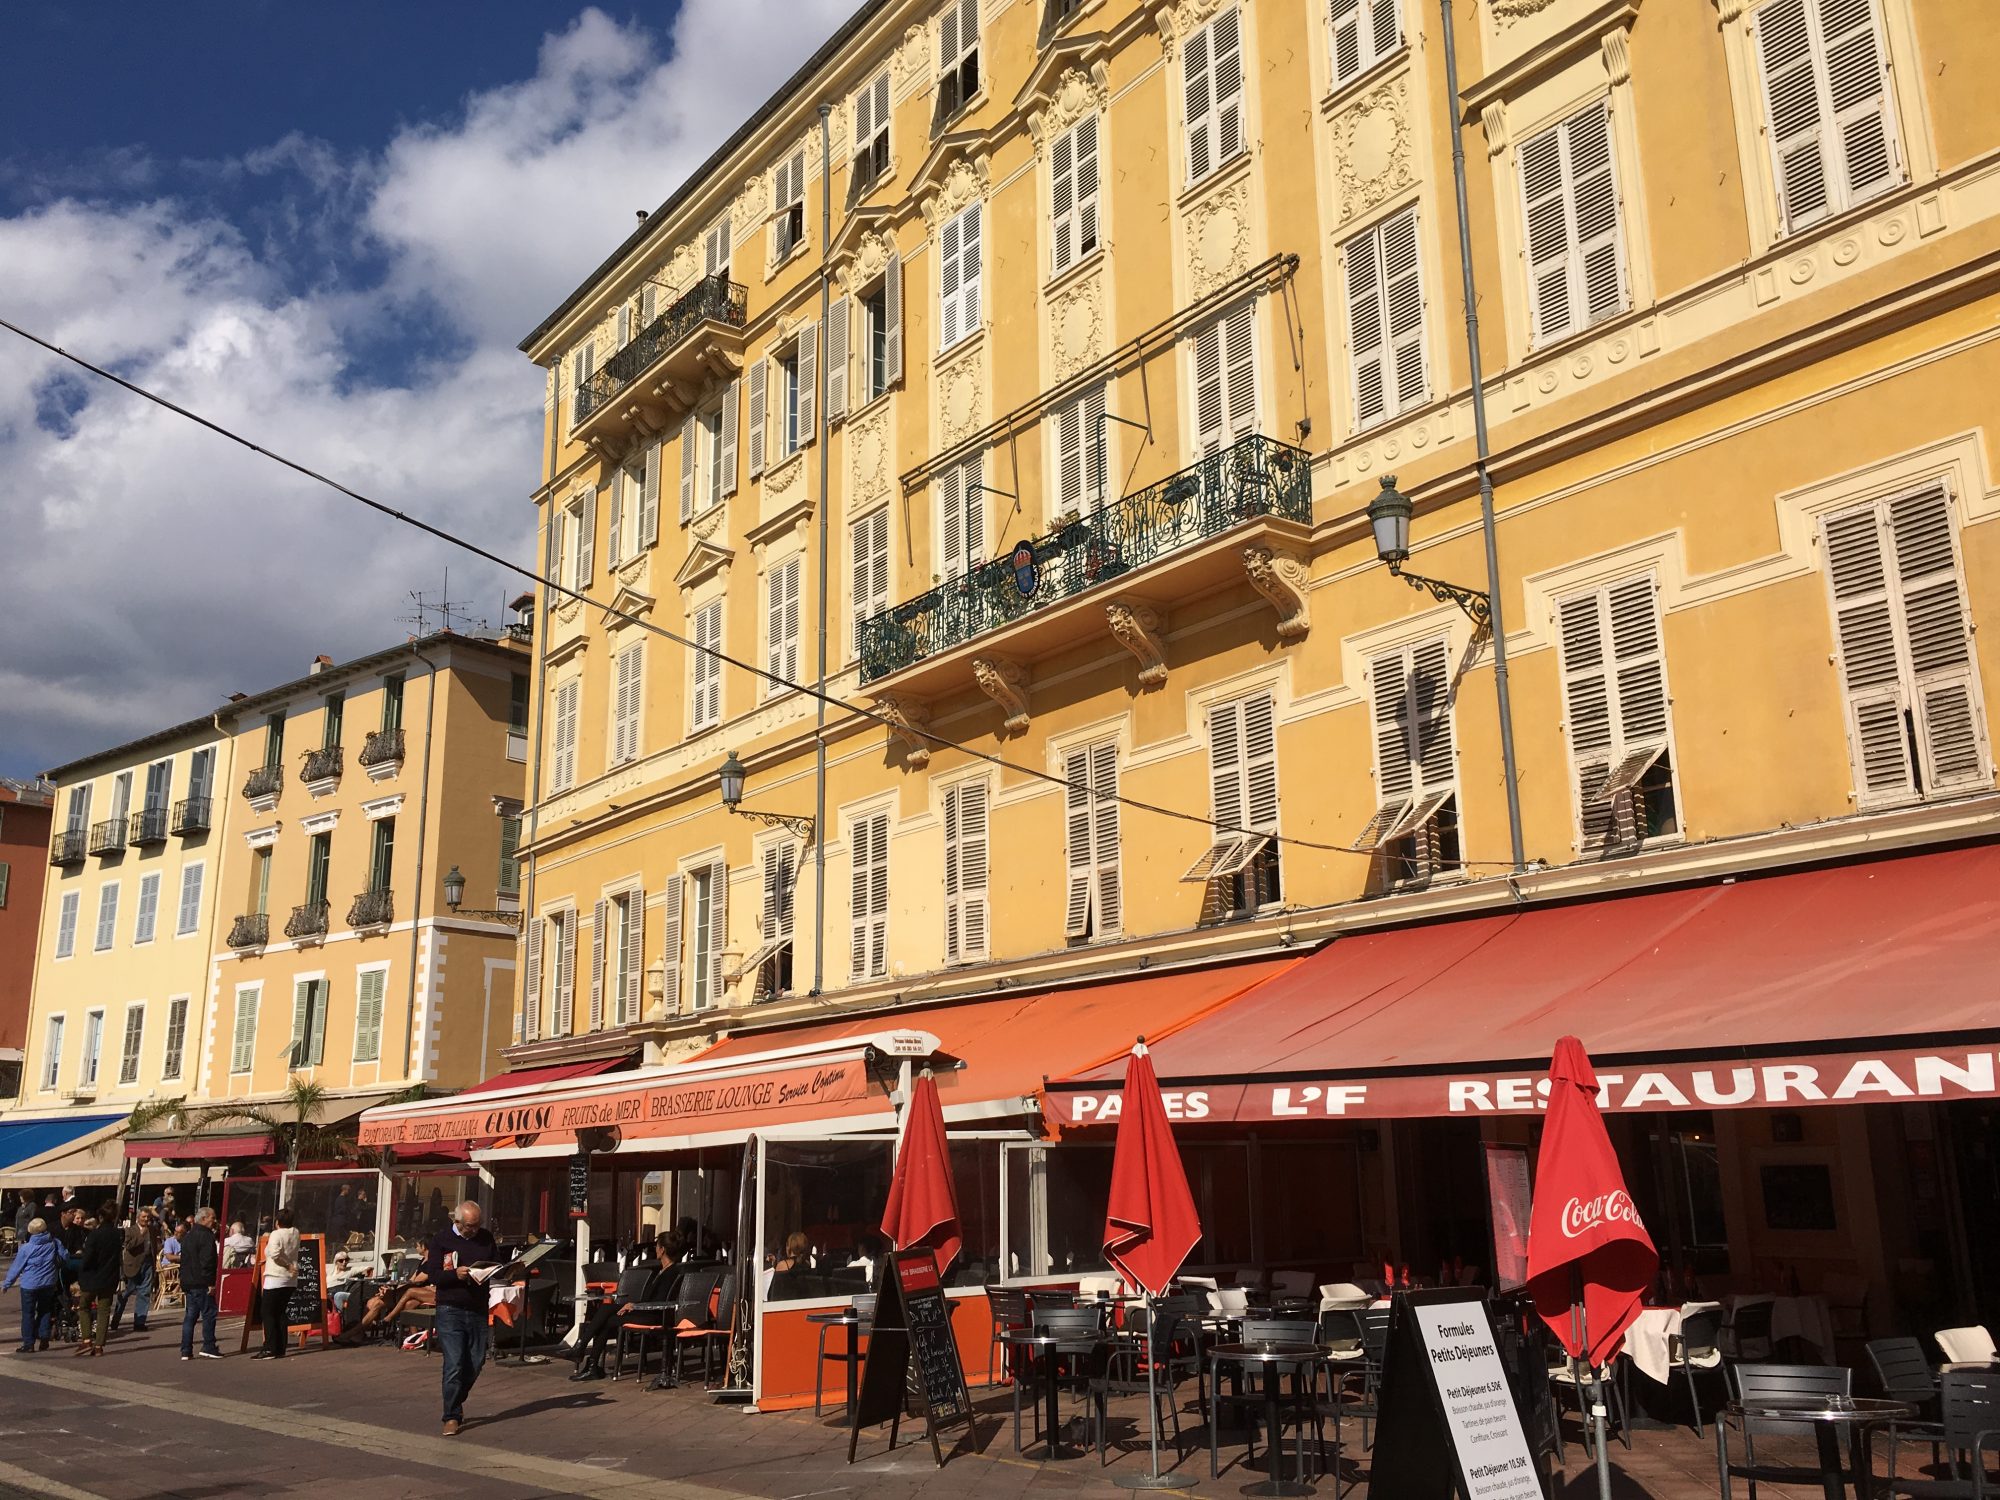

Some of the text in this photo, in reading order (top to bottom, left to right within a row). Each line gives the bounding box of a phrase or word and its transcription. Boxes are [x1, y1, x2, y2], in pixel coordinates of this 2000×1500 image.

[1072, 1091, 1209, 1121] PAES
[1448, 1053, 2000, 1112] RETAURAN
[561, 1104, 599, 1127] FRUITS
[599, 1102, 613, 1122] de
[615, 1099, 641, 1121] MER
[650, 1088, 715, 1118] BRASSERIE
[715, 1081, 775, 1109] LOUNGE
[778, 1082, 809, 1105] Service
[1561, 1189, 1646, 1238] Coca-Cola
[1437, 1321, 1475, 1339] Formules
[1430, 1344, 1495, 1363] Petits Déjeuners
[1446, 1387, 1462, 1399] Petit
[1460, 1385, 1487, 1398] Déjeuner
[1469, 1467, 1485, 1480] Petit
[1483, 1462, 1509, 1477] Déjeuner
